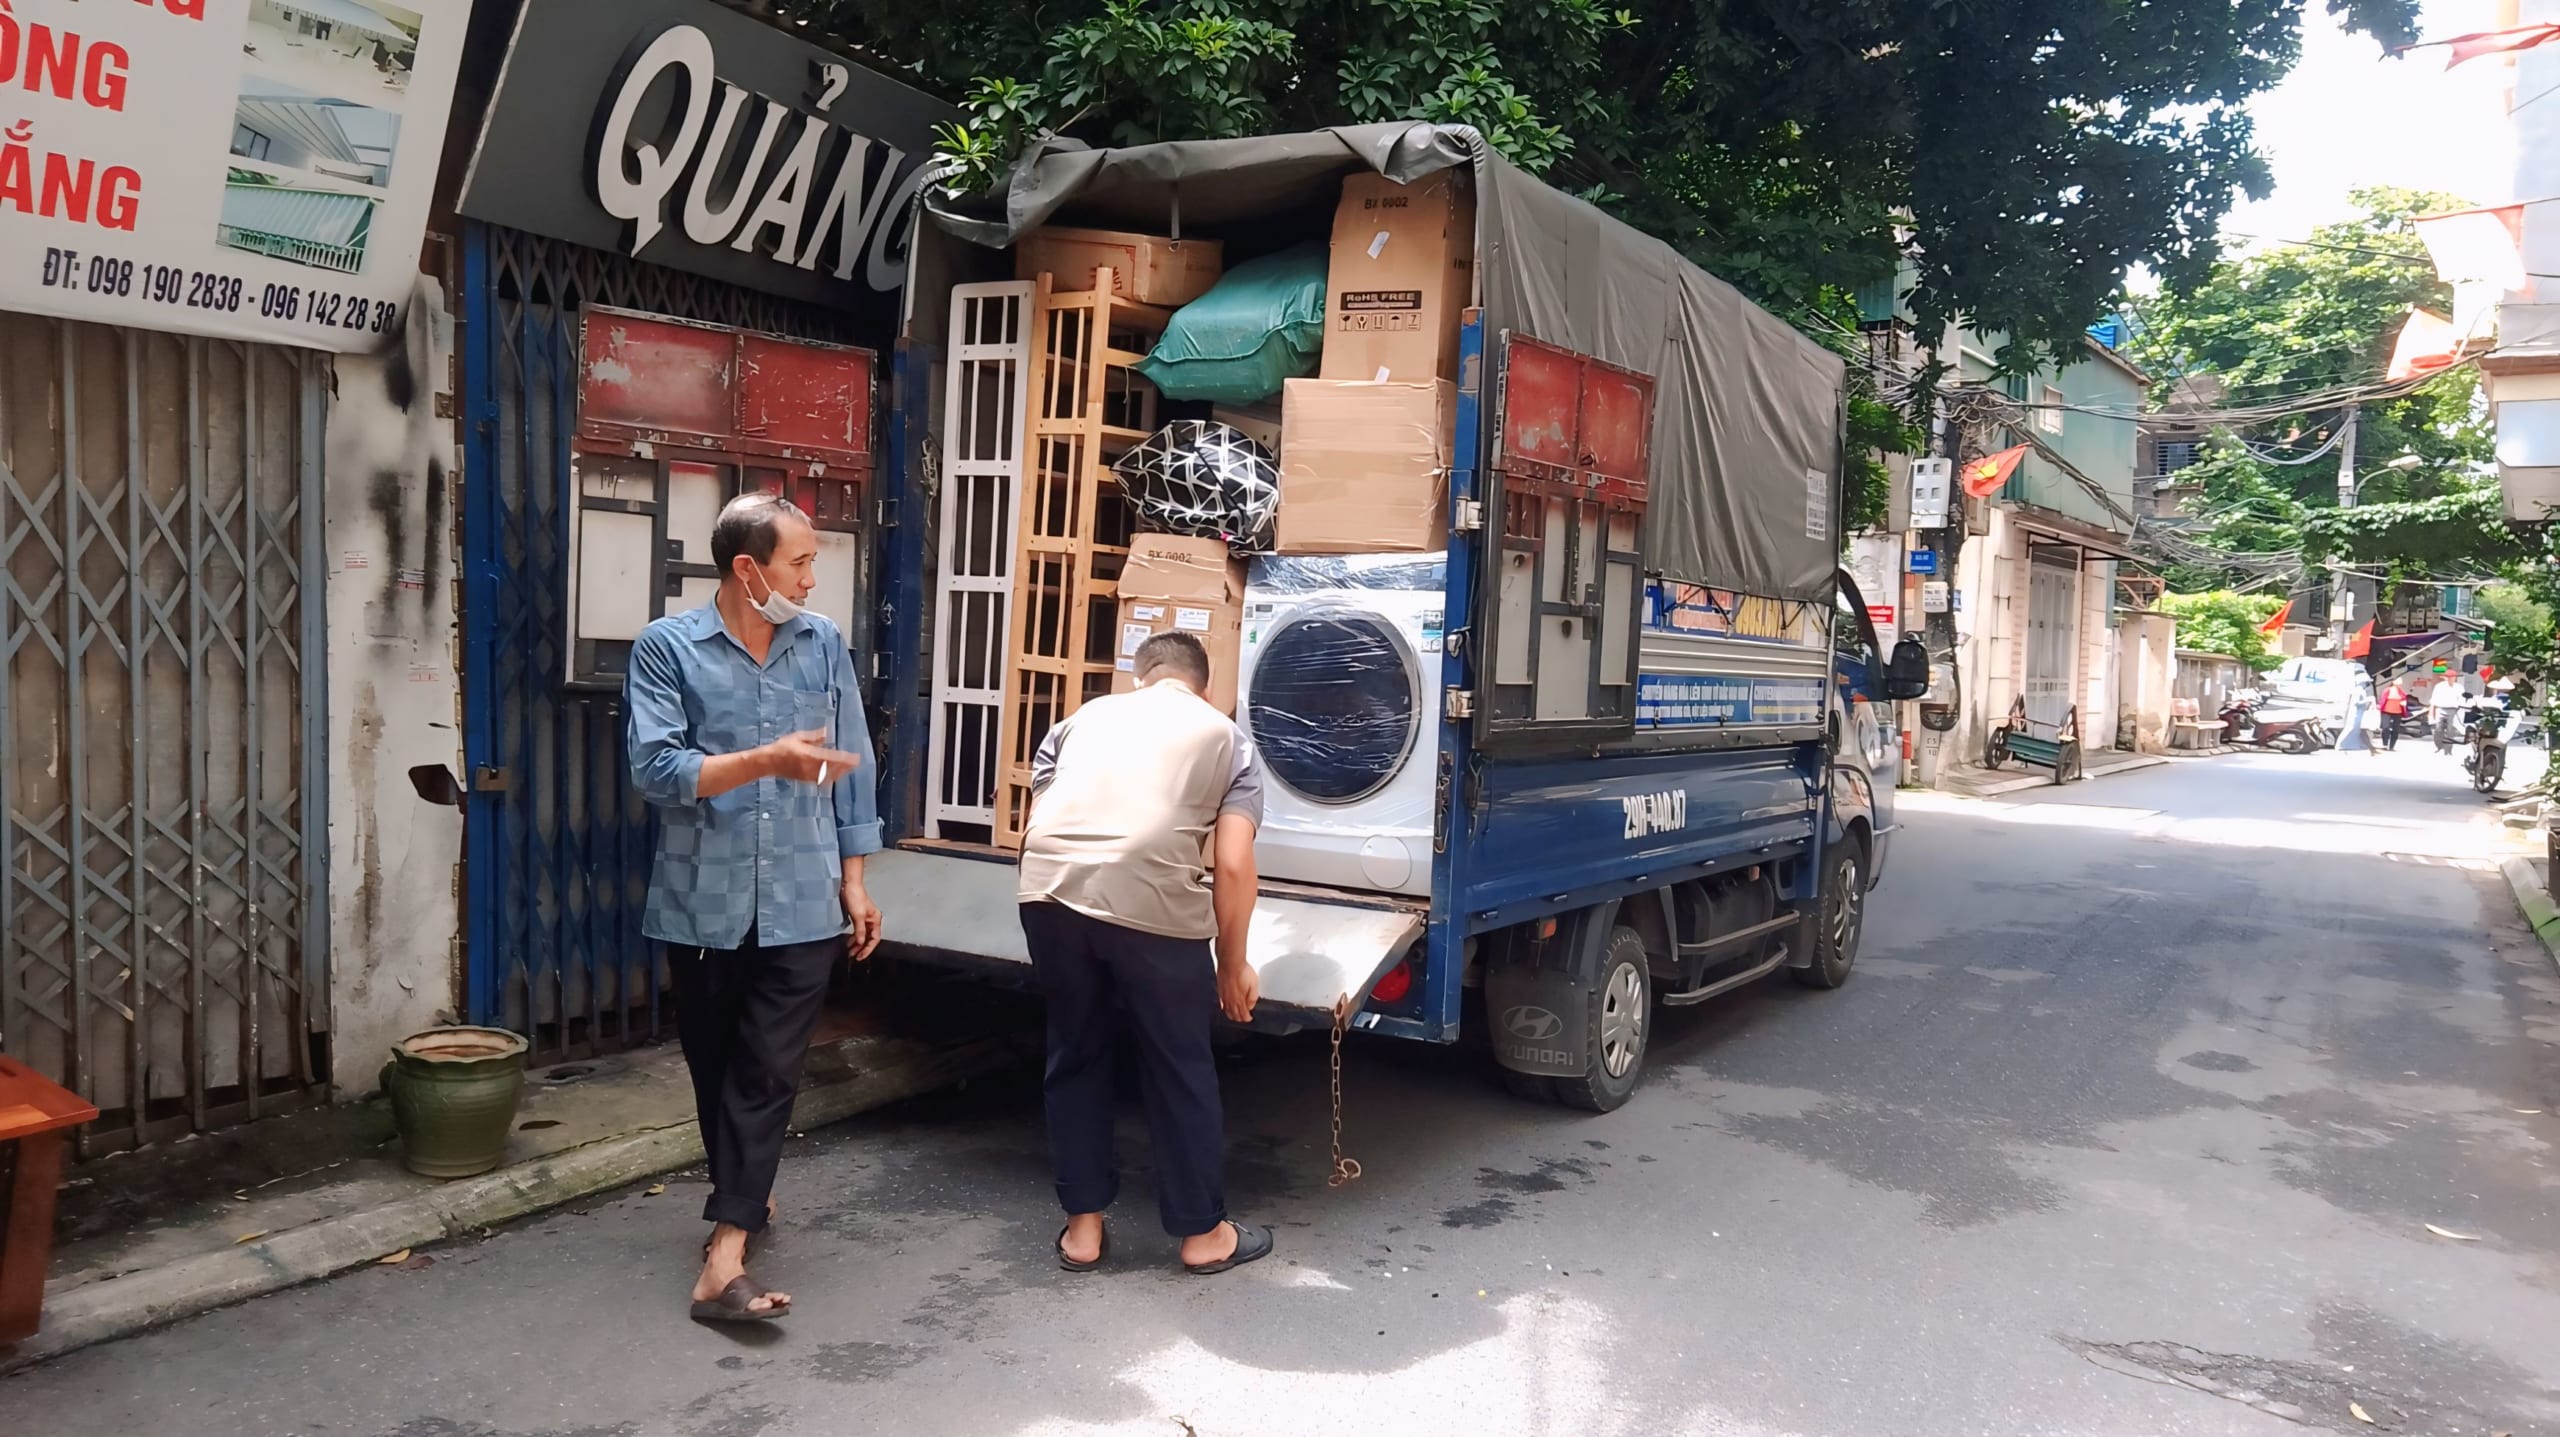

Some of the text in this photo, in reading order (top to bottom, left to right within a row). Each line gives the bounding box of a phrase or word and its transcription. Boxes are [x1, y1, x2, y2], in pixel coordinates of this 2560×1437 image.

[598, 25, 938, 291] QUẢNG
[43, 247, 80, 290] ĐT:
[88, 255, 133, 297] 098
[143, 265, 182, 304] 190
[187, 271, 242, 312] 2838
[261, 284, 299, 320] 096
[306, 289, 340, 327] 142
[343, 296, 367, 330] 28
[371, 300, 396, 333] 38
[1346, 292, 1415, 302] RoHS FREE
